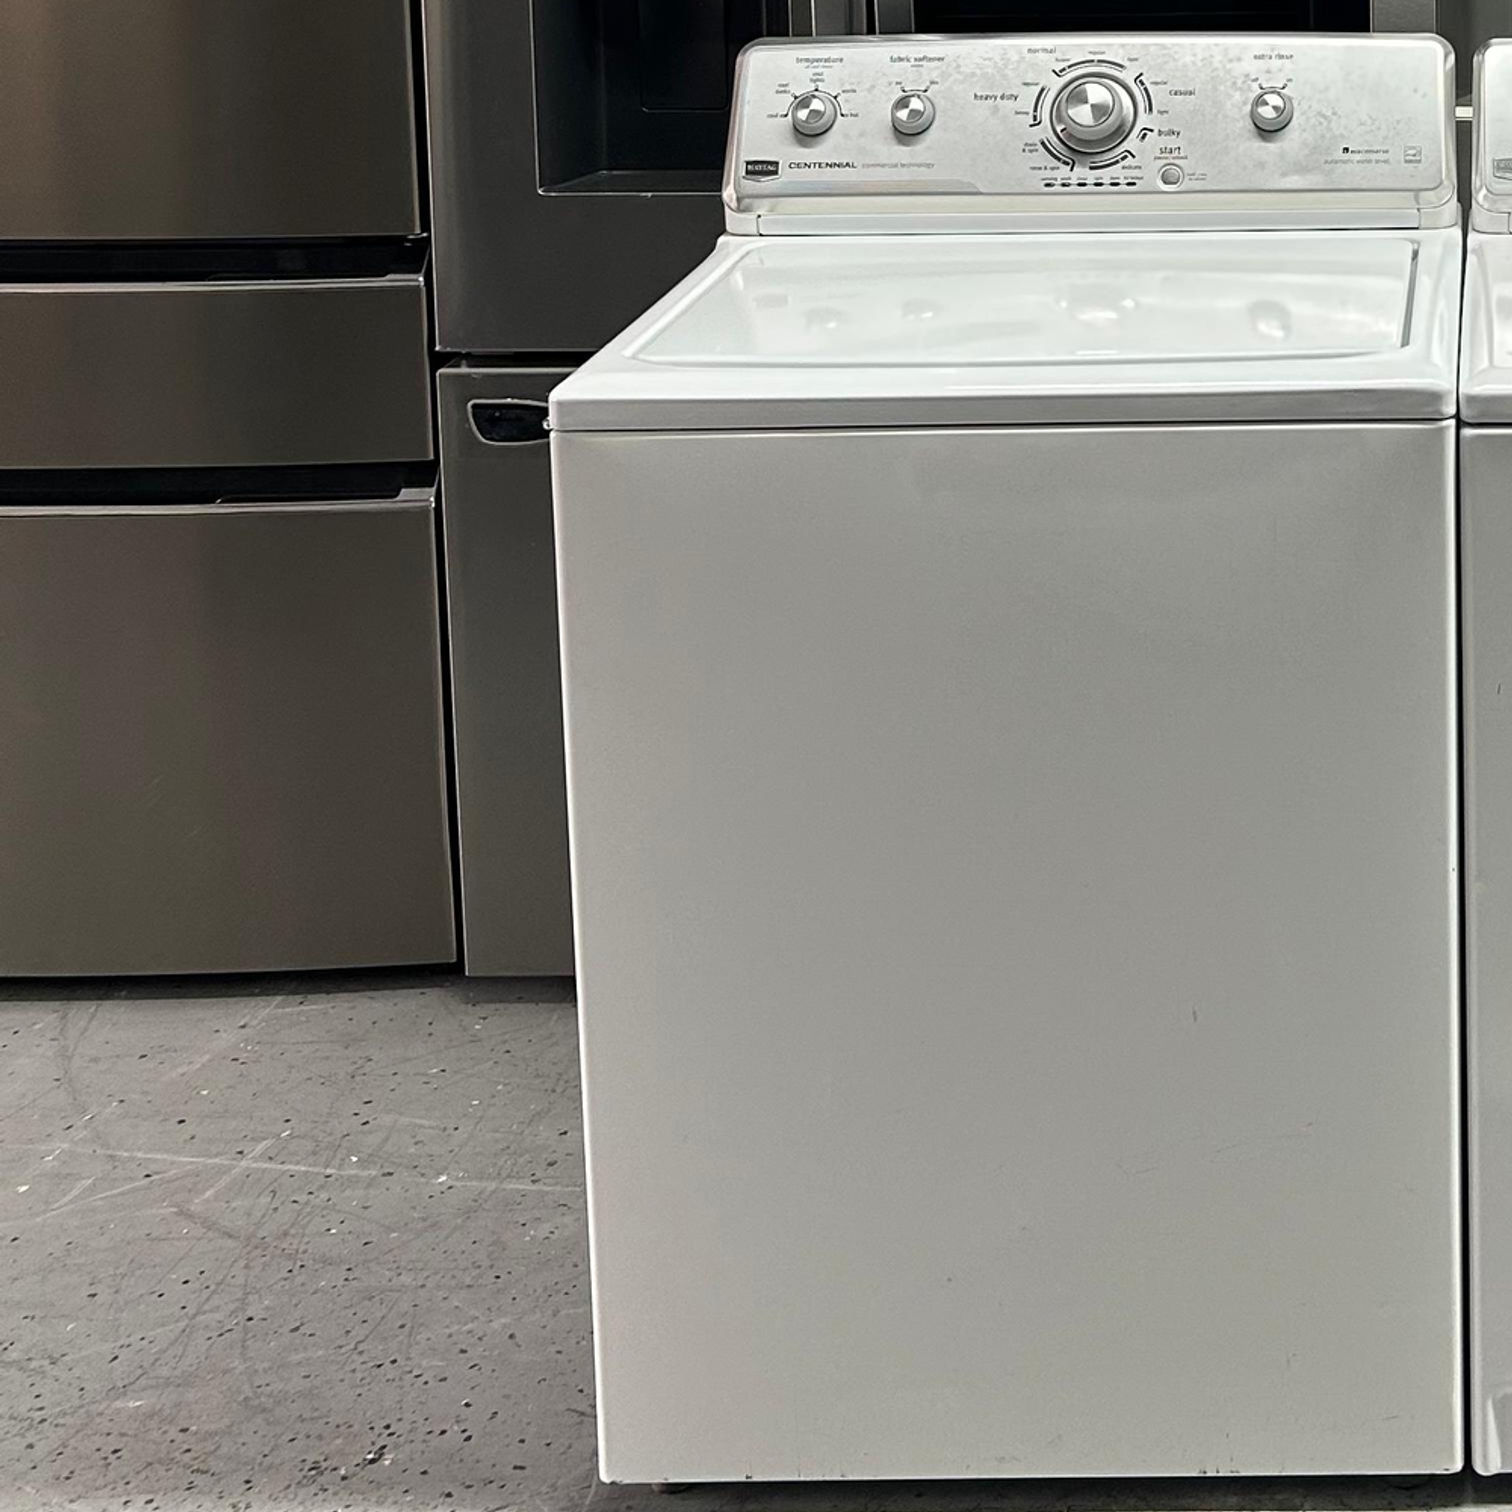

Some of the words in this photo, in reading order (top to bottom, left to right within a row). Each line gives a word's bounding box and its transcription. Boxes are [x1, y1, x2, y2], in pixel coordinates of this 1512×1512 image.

[795, 56, 844, 65] temperature
[1168, 88, 1196, 97] casual
[973, 92, 998, 103] heavy
[999, 92, 1020, 102] duty
[1158, 129, 1181, 139] bulky
[1159, 146, 1181, 155] start
[788, 161, 858, 170] CENTENNIAL
